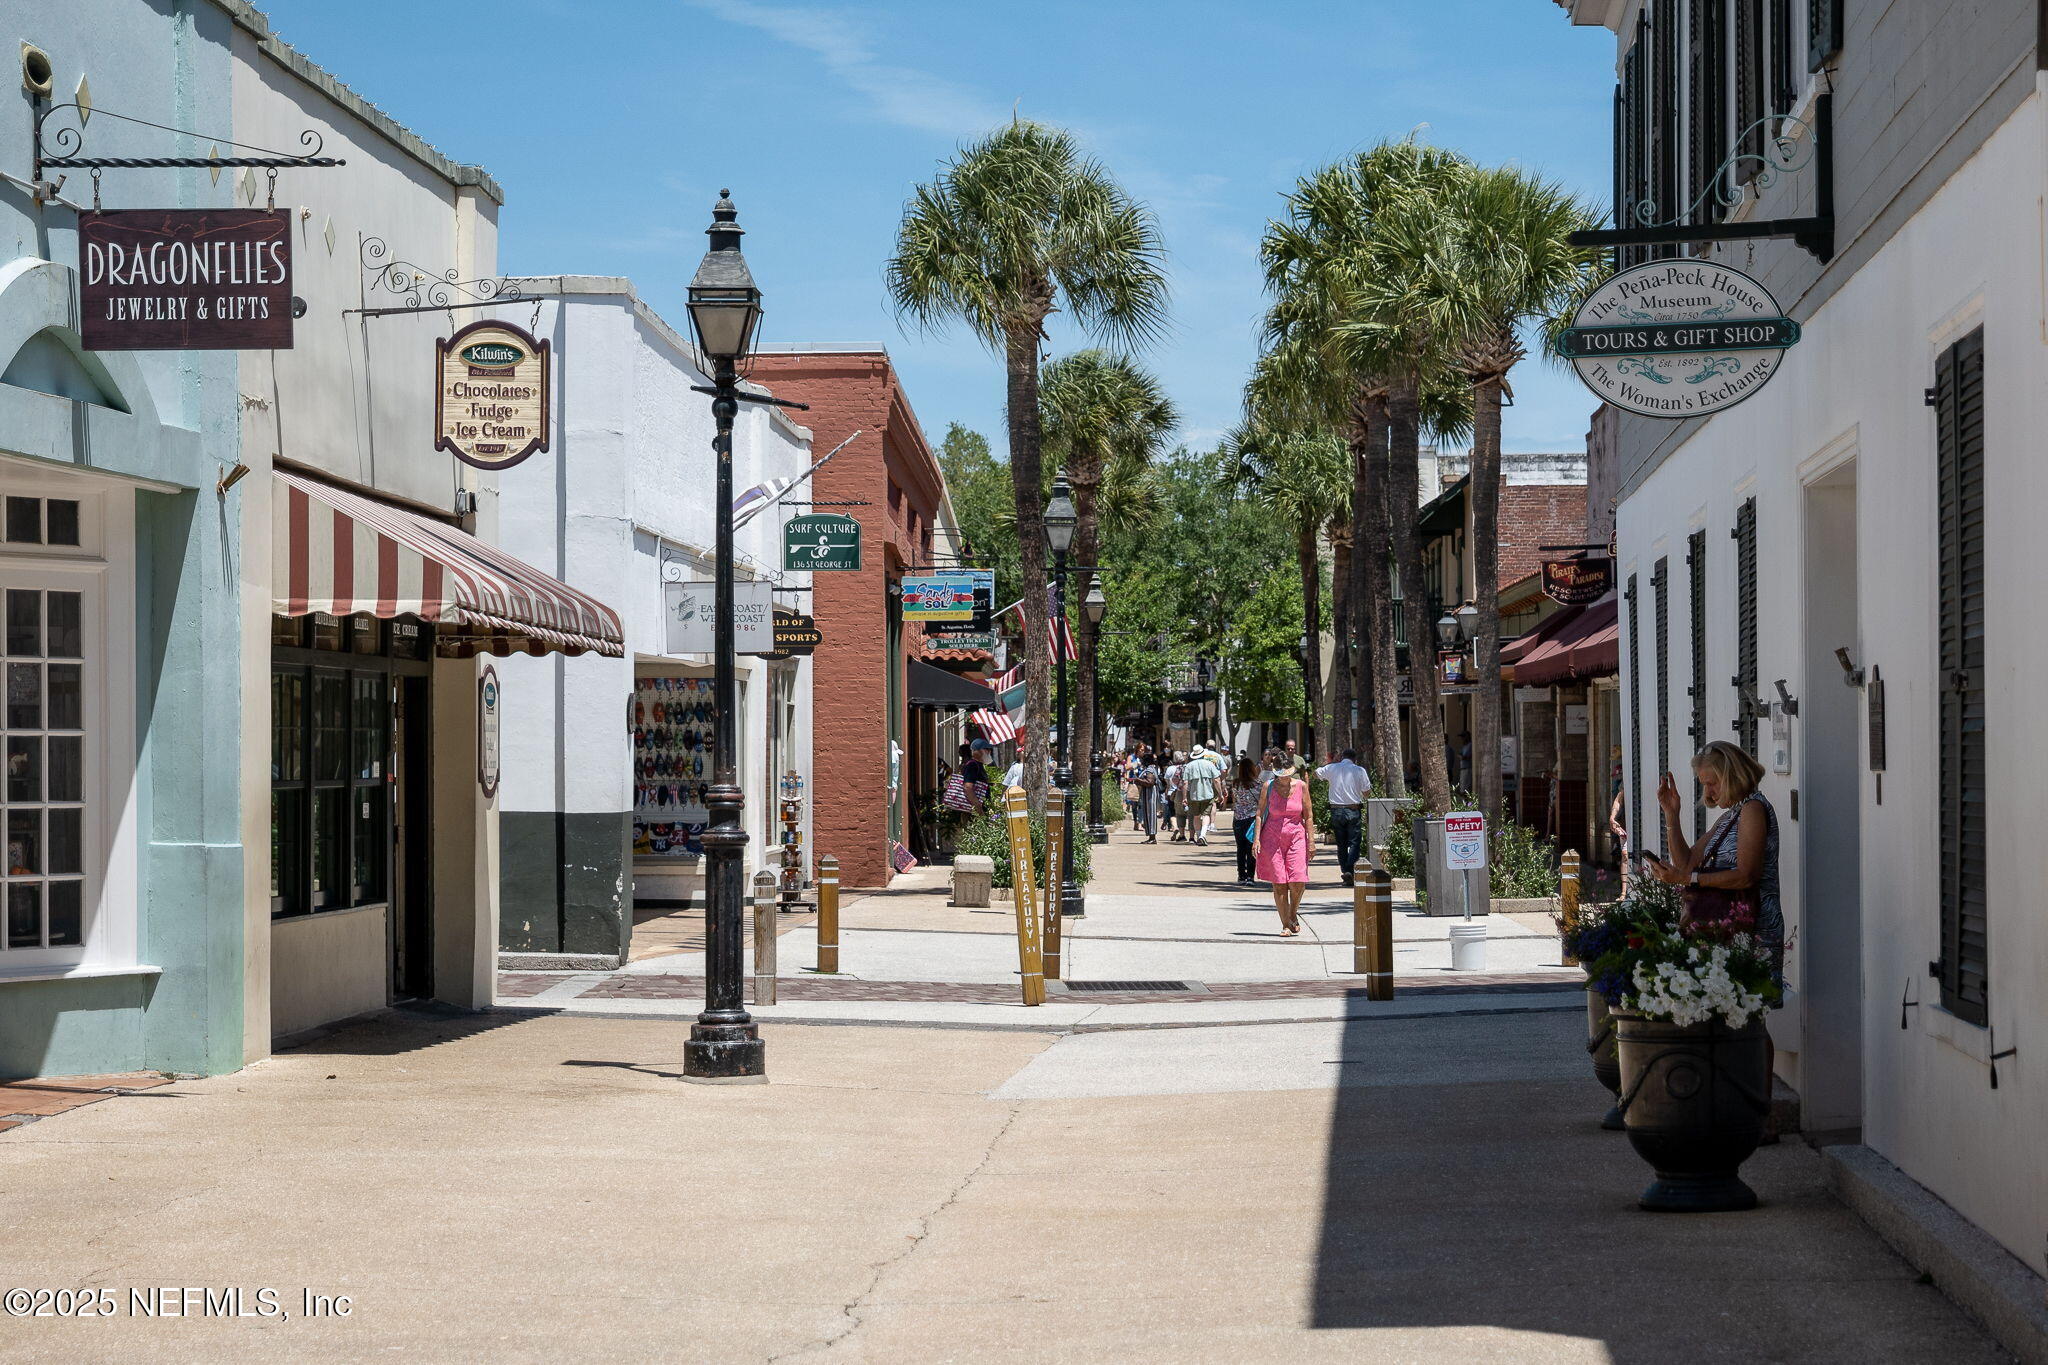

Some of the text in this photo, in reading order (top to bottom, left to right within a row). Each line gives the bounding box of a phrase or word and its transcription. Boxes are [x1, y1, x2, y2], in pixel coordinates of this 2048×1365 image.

[87, 241, 286, 286] DRAGONFLIES
[1588, 267, 1764, 321] The Peña-Peck House
[1639, 294, 1713, 310] Museum
[105, 296, 269, 321] JEWELRY & GIFTS
[1653, 312, 1699, 322] Circa 1750
[1582, 326, 1776, 350] TOURS & GIFT SHOP
[471, 346, 514, 361] Kilwin's
[1676, 358, 1700, 367] 1892
[453, 381, 531, 398] Chocolates
[1590, 358, 1771, 410] The Woman's Exchange
[470, 402, 513, 421] Fudge
[456, 421, 525, 438] Ice Cream
[789, 523, 856, 534] SURF CULTURE
[916, 581, 955, 605] Sandy
[925, 600, 948, 609] SOL
[775, 633, 818, 642] SPORTS
[1447, 821, 1480, 831] SAFETY
[1048, 841, 1057, 921] TREASURY
[1018, 848, 1033, 939] TREASURY
